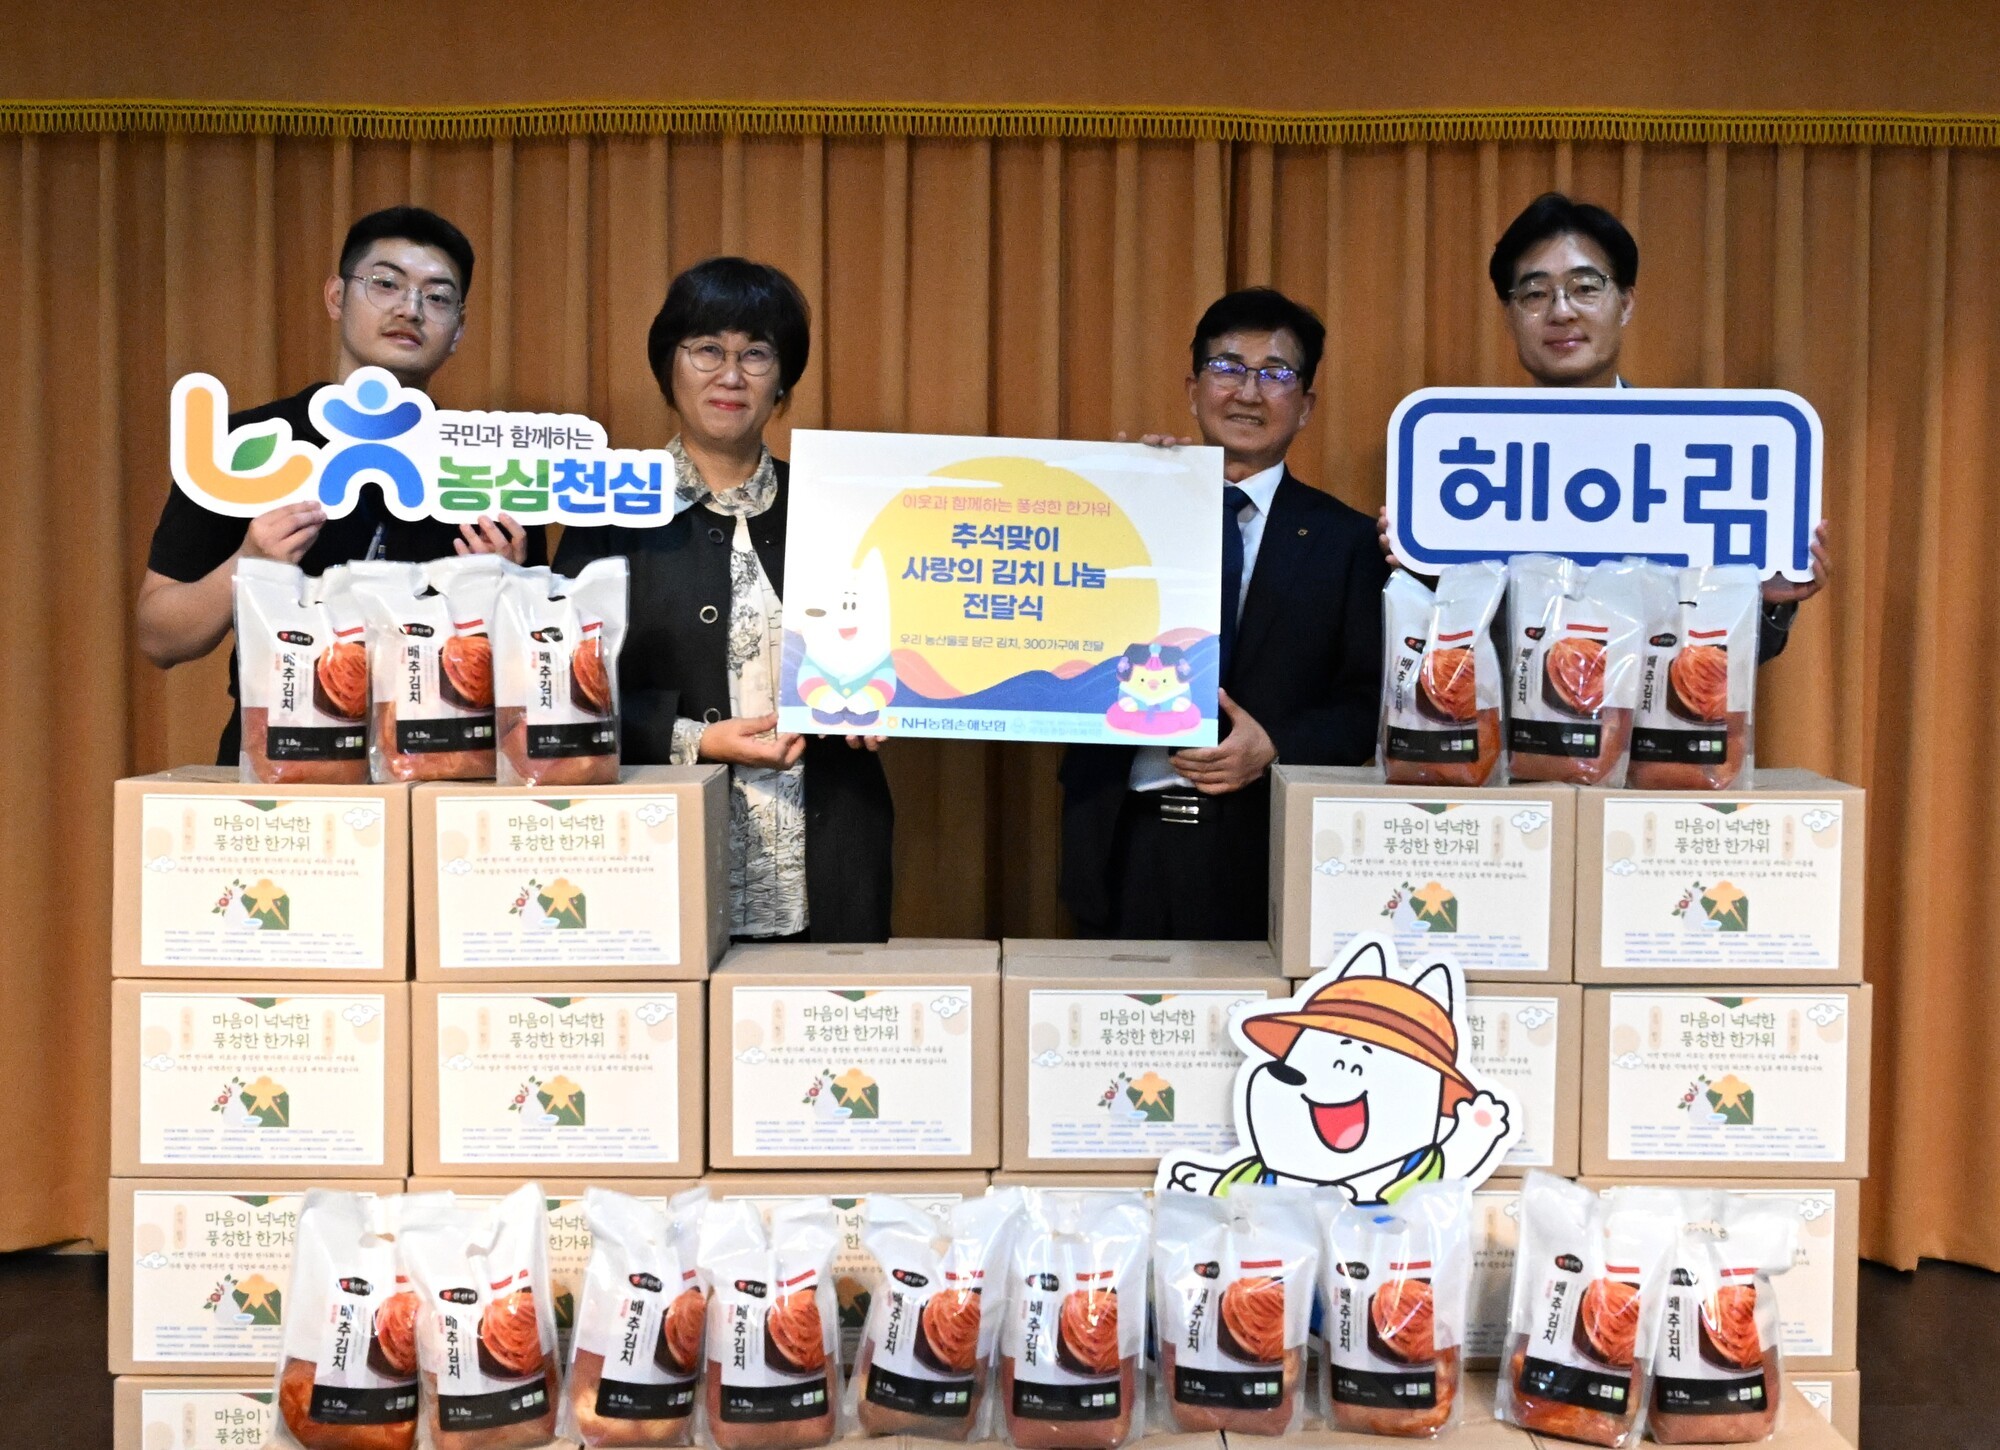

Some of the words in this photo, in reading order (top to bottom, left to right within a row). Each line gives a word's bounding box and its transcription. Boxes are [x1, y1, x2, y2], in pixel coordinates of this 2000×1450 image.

[439, 423, 503, 448] 국민과
[510, 426, 593, 450] 함께하는
[437, 456, 662, 515] 농심천심
[903, 495, 948, 510] 이웃과
[953, 496, 1013, 513] 함께하는
[1017, 498, 1061, 515] 풍성한
[1066, 501, 1111, 516] 한가위
[1439, 436, 1769, 570] 헤아림
[951, 522, 1059, 552] 추석맞이
[902, 556, 983, 584] 사랑의
[992, 559, 1044, 586] 김치
[1054, 561, 1106, 589] 나눔
[963, 593, 1043, 621] 전달식
[900, 633, 922, 645] 우리
[925, 635, 969, 647] 농산물로
[1024, 638, 1079, 651] 300가구에
[1082, 640, 1104, 652] 전달
[214, 815, 260, 832] 마음이
[265, 815, 311, 833] 넉넉한
[509, 814, 554, 831] 마음이
[560, 814, 605, 832] 넉넉한
[1384, 818, 1429, 835] 마음이
[1435, 818, 1480, 836] 넉넉한
[1675, 818, 1720, 834] 마음이
[1725, 818, 1770, 836] 넉넉한
[214, 834, 260, 852] 풍성한
[265, 835, 310, 851] 한가위
[509, 834, 555, 851] 풍성한
[560, 833, 605, 851] 한가위
[1384, 838, 1429, 855] 풍성한
[1435, 839, 1479, 854] 한가위
[1675, 838, 1720, 854] 풍성한
[1725, 838, 1770, 854] 한가위
[212, 1013, 259, 1029] 마음이
[265, 1013, 310, 1030] 넉넉한
[509, 1013, 554, 1029] 마음이
[560, 1012, 604, 1029] 넉넉한
[804, 1006, 849, 1022] 마음이
[855, 1005, 899, 1022] 넉넉한
[1101, 1009, 1145, 1026] 마음이
[1151, 1009, 1195, 1026] 넉넉한
[1681, 1012, 1725, 1028] 마음이
[1731, 1012, 1776, 1029] 넉넉한
[212, 1033, 259, 1049] 풍성한
[265, 1033, 310, 1049] 한가위
[509, 1032, 554, 1048] 풍성한
[560, 1032, 605, 1048] 한가위
[804, 1025, 849, 1042] 풍성한
[854, 1025, 899, 1041] 한가위
[1101, 1029, 1145, 1045] 풍성한
[1151, 1029, 1195, 1045] 한가위
[1681, 1032, 1725, 1048] 풍성한
[1731, 1031, 1775, 1048] 한가위
[205, 1210, 251, 1228] 마음이
[205, 1230, 251, 1247] 풍성한
[549, 1234, 593, 1251] 한가위
[620, 1300, 644, 1366] 배추김치
[215, 1408, 261, 1425] 마음이
[215, 1428, 261, 1444] 풍성한
